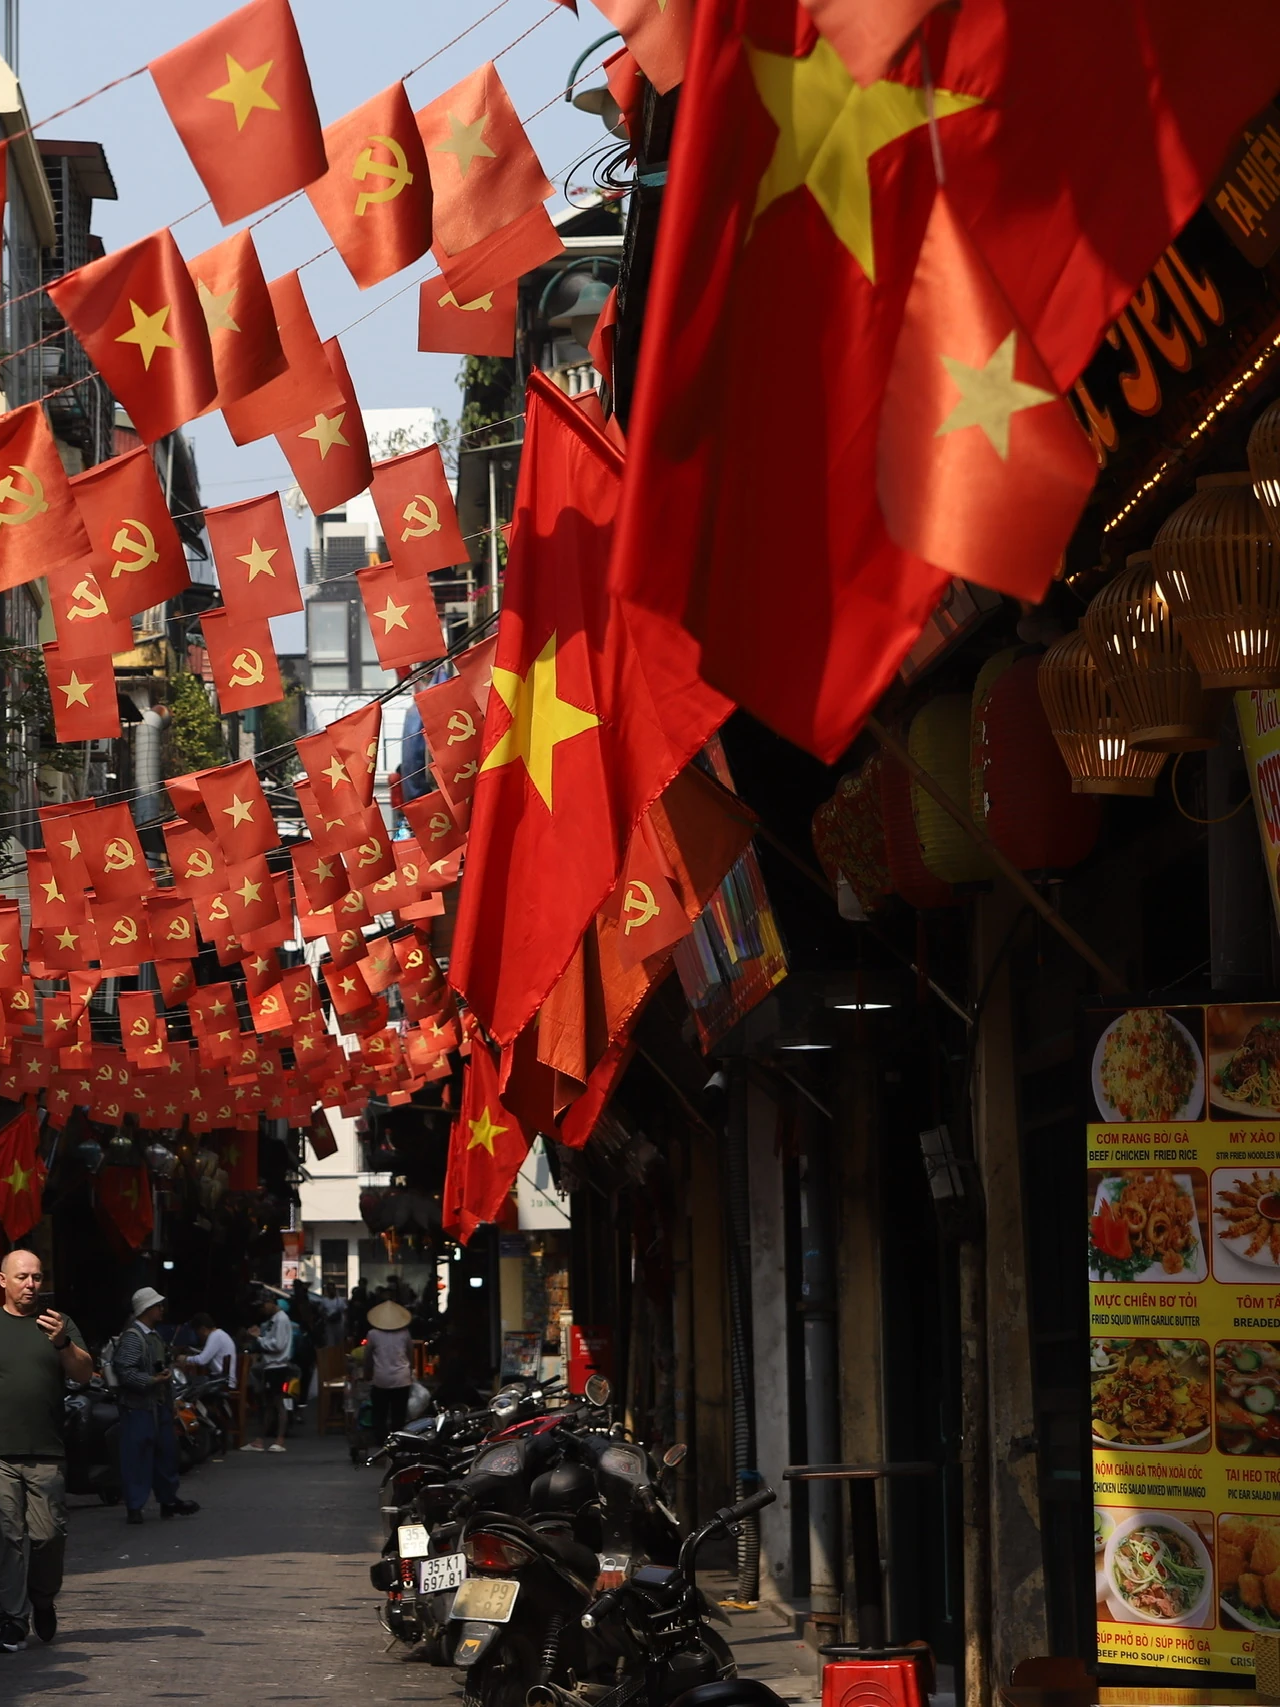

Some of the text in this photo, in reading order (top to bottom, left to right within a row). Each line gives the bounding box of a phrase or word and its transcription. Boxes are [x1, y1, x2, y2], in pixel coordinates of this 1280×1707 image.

[1122, 1132, 1151, 1144] RANG
[1174, 1129, 1189, 1143] GÀ
[1250, 1128, 1276, 1143] XÀO
[1089, 1150, 1109, 1161] BEEF
[1115, 1150, 1150, 1161] CHICKEN
[1154, 1150, 1177, 1160] FRIED
[1179, 1149, 1197, 1160] RICE
[1215, 1151, 1229, 1160] STIR
[1230, 1151, 1247, 1159] FRIED
[1247, 1151, 1275, 1160] NOODLES
[1094, 1294, 1121, 1309] MỰC
[1124, 1293, 1156, 1307] CHIÊN
[1236, 1294, 1264, 1308] TÔM
[1092, 1314, 1200, 1327] FRIED SQUID WITH GARLIC BUTTER
[1233, 1317, 1280, 1328] BREADED
[1114, 1461, 1134, 1476] CHÂN
[1136, 1462, 1146, 1477] GÀ
[1225, 1468, 1240, 1481] TAI
[1242, 1469, 1262, 1482] HEO
[1093, 1482, 1206, 1498] CHICKEN LEG SALAD MIXED WITH MANGO
[1239, 1489, 1251, 1500] EAR
[1252, 1490, 1271, 1500] SALAD
[428, 1556, 460, 1576] 35-K1
[423, 1571, 464, 1592] 697.81
[1096, 1630, 1112, 1644] SÚP
[1115, 1631, 1134, 1645] PHỞ
[1136, 1633, 1149, 1647] BÒ
[1155, 1634, 1173, 1649] SÚP
[1176, 1635, 1194, 1651] PHỞ
[1197, 1638, 1211, 1652] GÀ
[1097, 1650, 1118, 1659] BEEF
[1120, 1651, 1139, 1660] PHO
[1141, 1653, 1165, 1662] SOUP
[1171, 1655, 1210, 1666] CHICKEN
